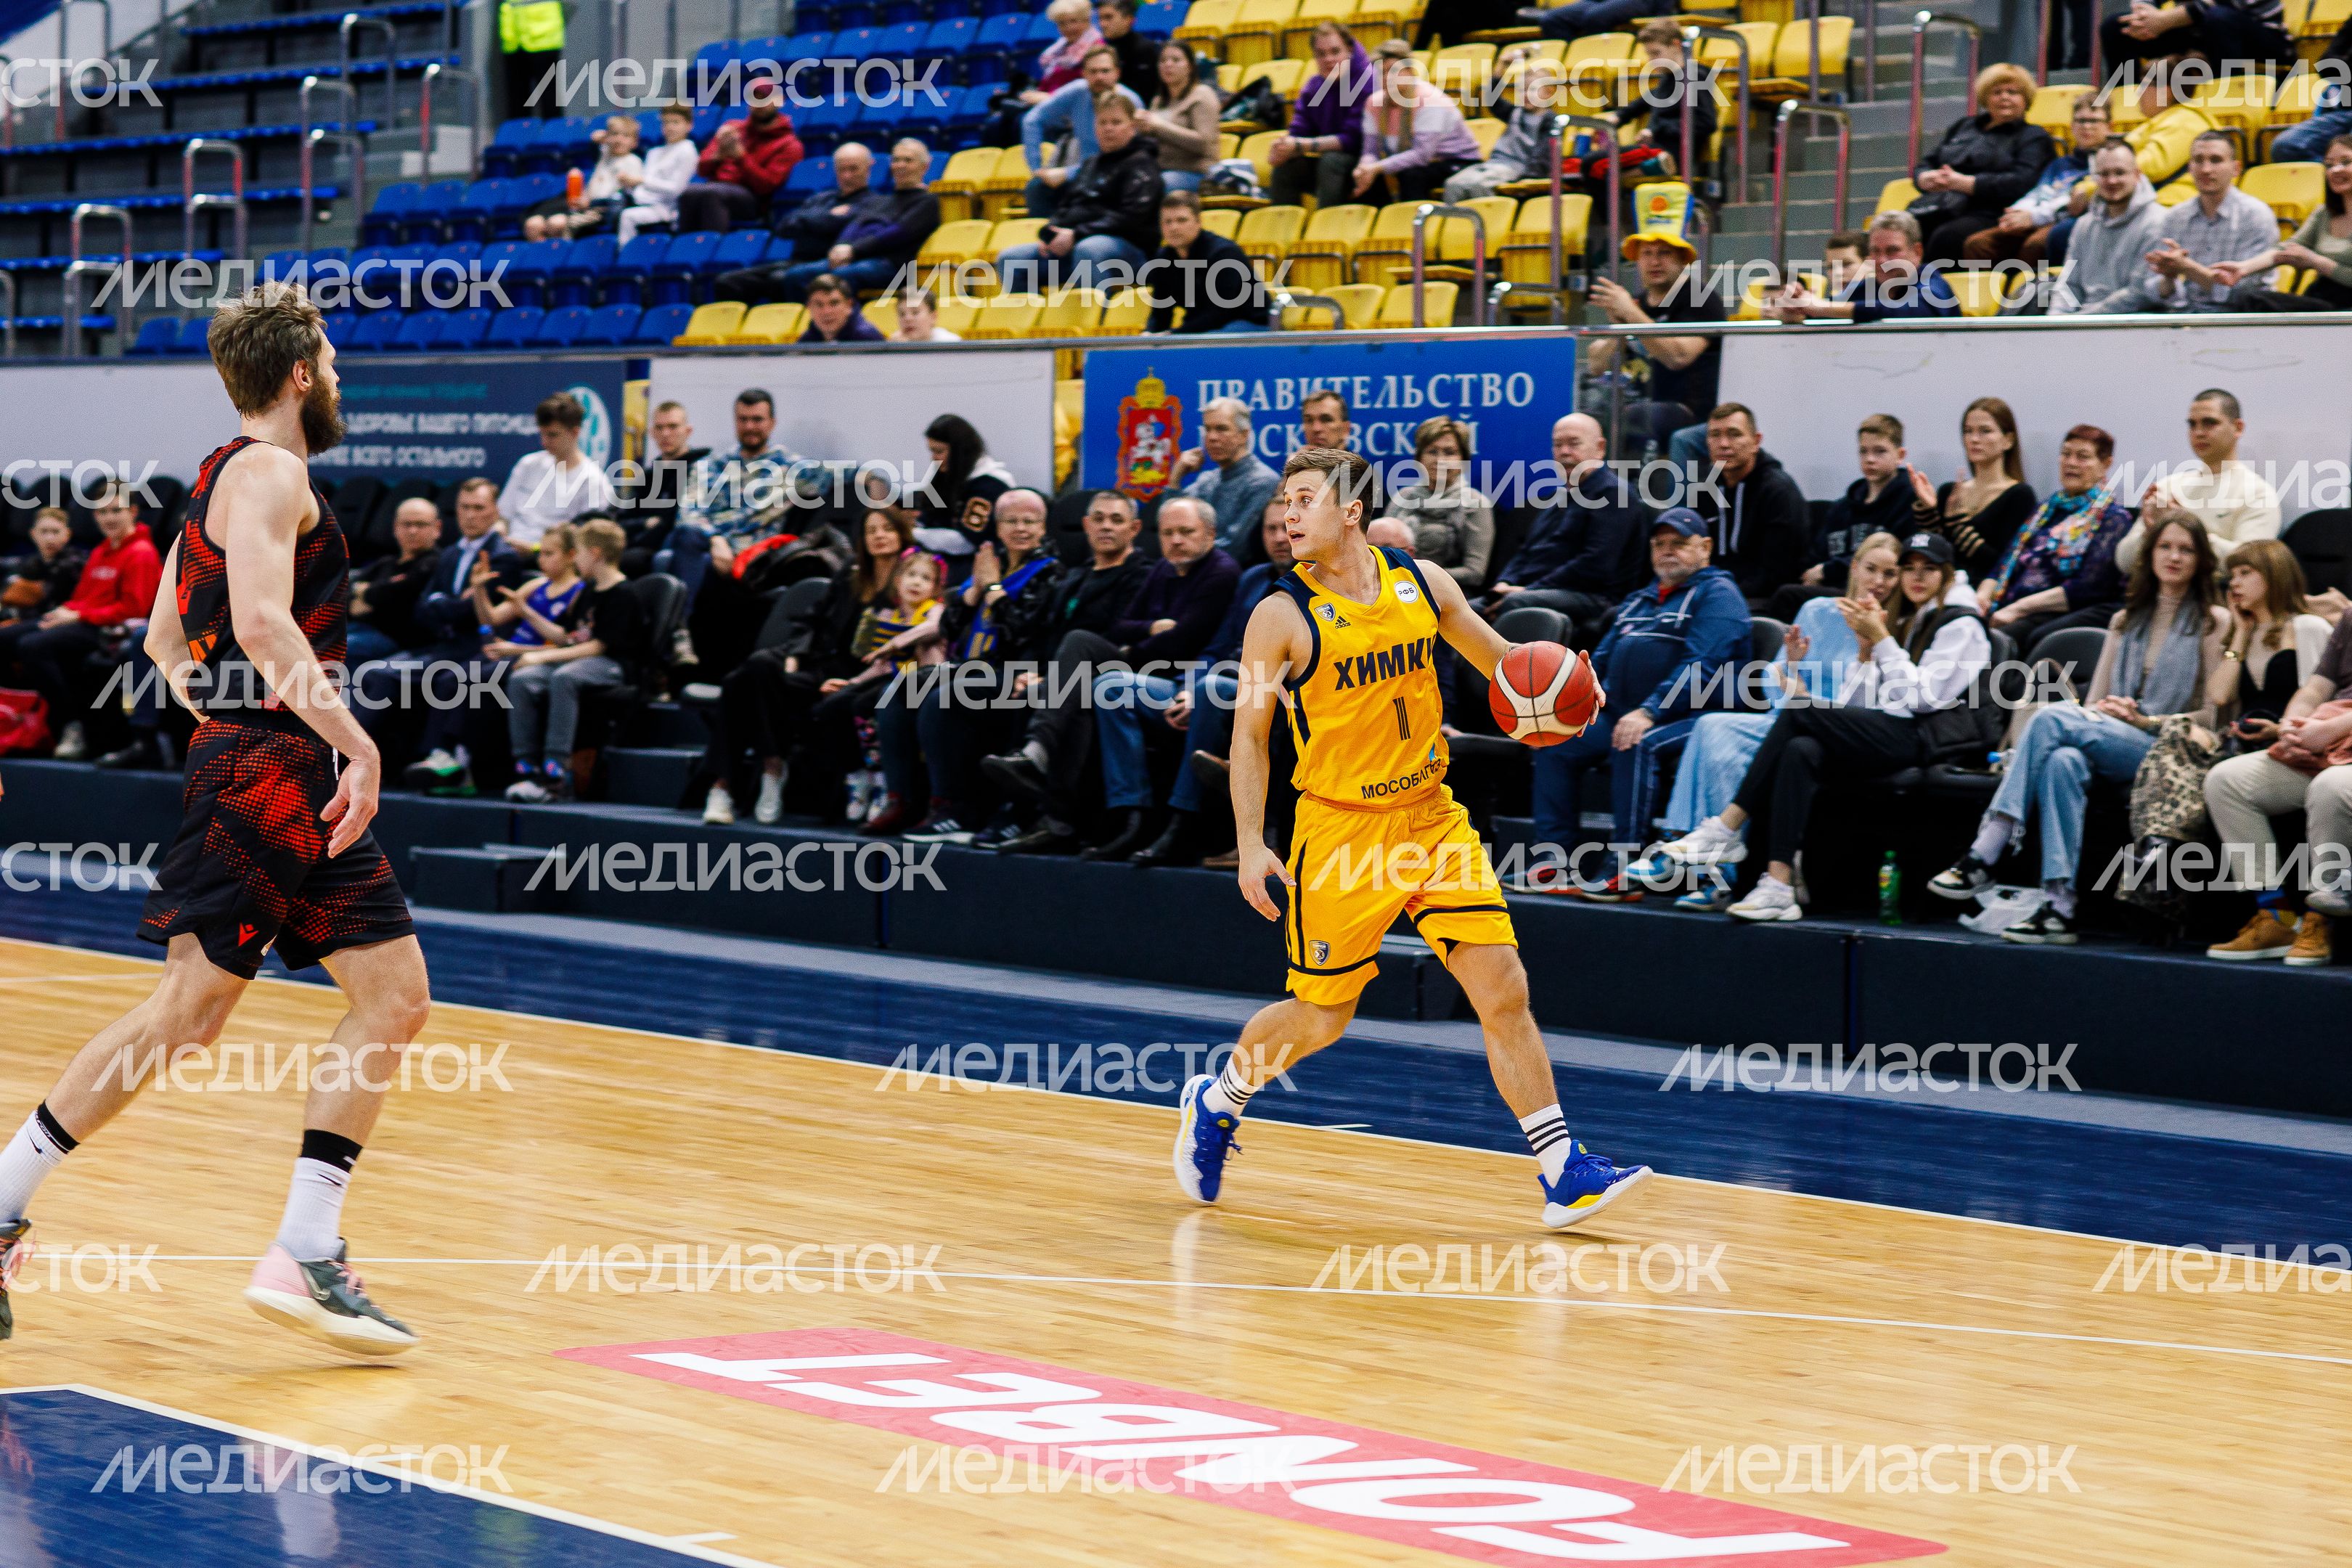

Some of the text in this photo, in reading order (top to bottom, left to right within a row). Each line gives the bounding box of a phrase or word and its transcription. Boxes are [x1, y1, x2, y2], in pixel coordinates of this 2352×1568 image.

[1198, 372, 1535, 412] ПРАВИТЕЛЬСТВО
[1198, 413, 1479, 457] СКВСКЙ
[1398, 587, 1414, 596] РФБ
[627, 1352, 1852, 1561] FONBET
